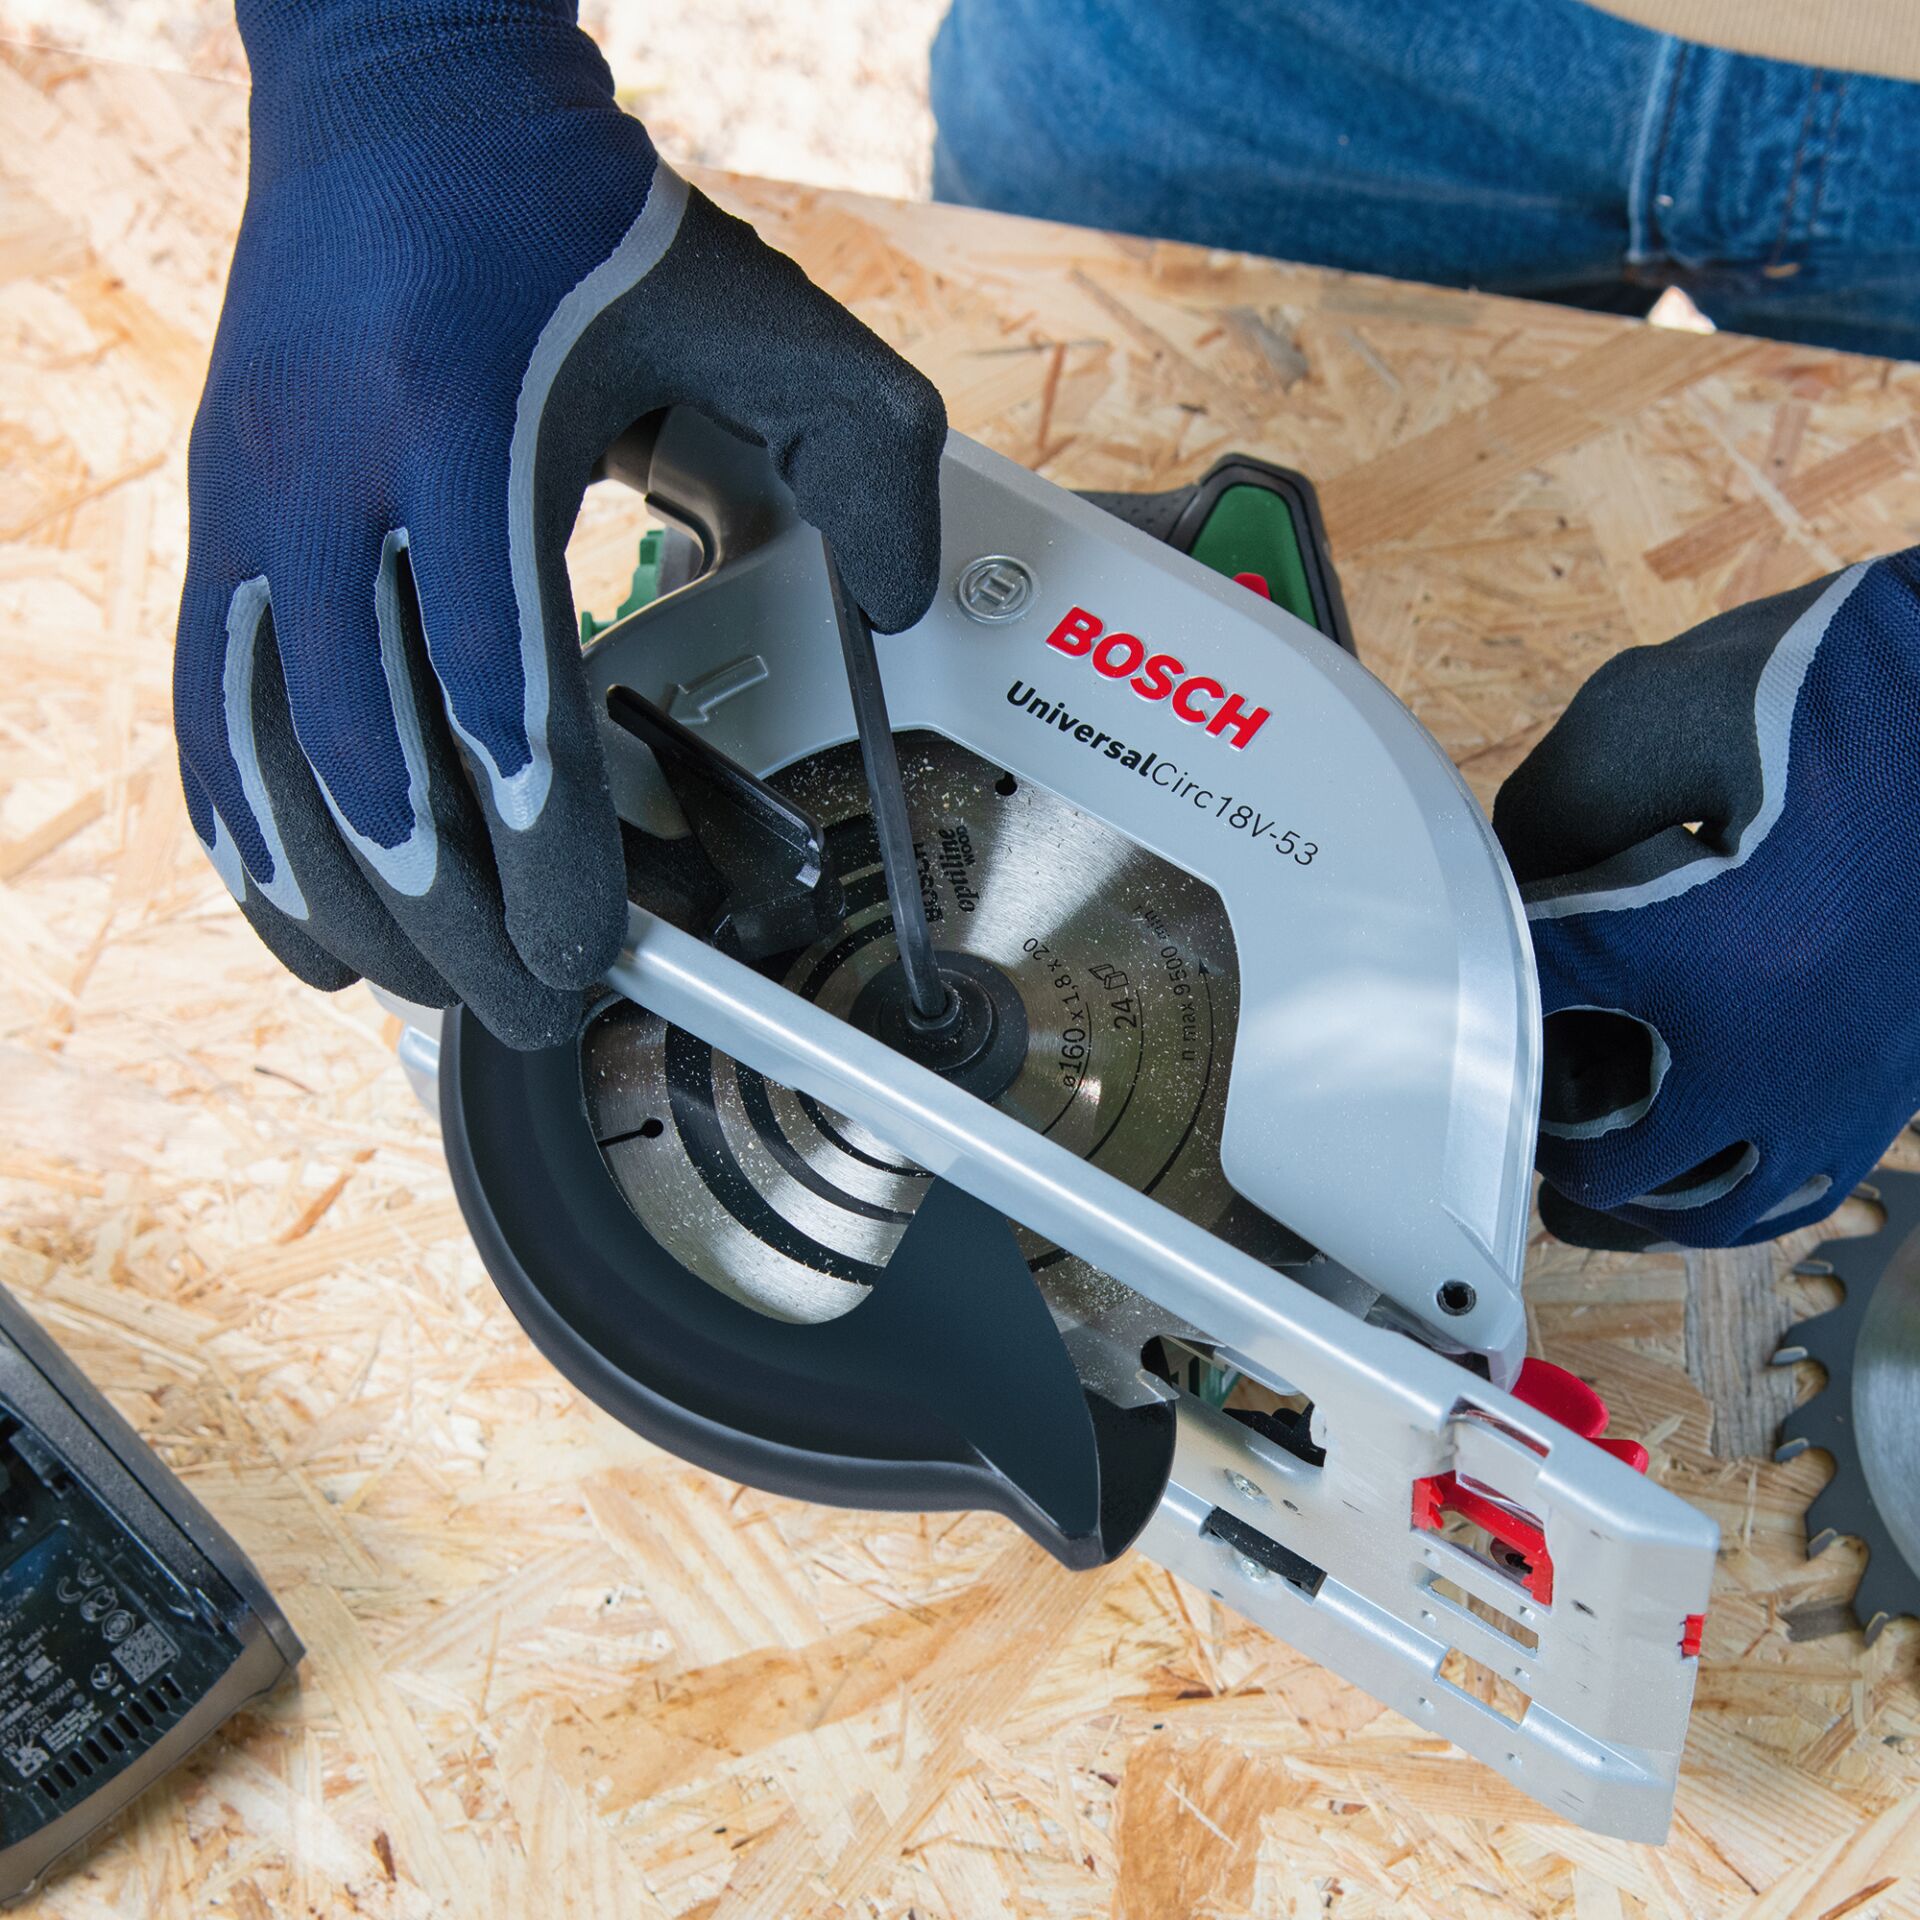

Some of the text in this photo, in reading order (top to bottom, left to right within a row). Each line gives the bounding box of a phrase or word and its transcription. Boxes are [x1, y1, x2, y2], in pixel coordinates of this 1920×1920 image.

[1045, 606, 1271, 751] BOSCH
[956, 825, 976, 865] WOOD
[938, 828, 980, 912] optiline
[1023, 938, 1050, 961] 20
[1047, 958, 1062, 972] x
[1160, 945, 1191, 996] 9500
[1054, 974, 1080, 1005] 1,8
[1070, 1009, 1085, 1021] x
[1111, 998, 1137, 1030] 24
[1181, 1002, 1197, 1042] max
[1182, 1050, 1196, 1061] n
